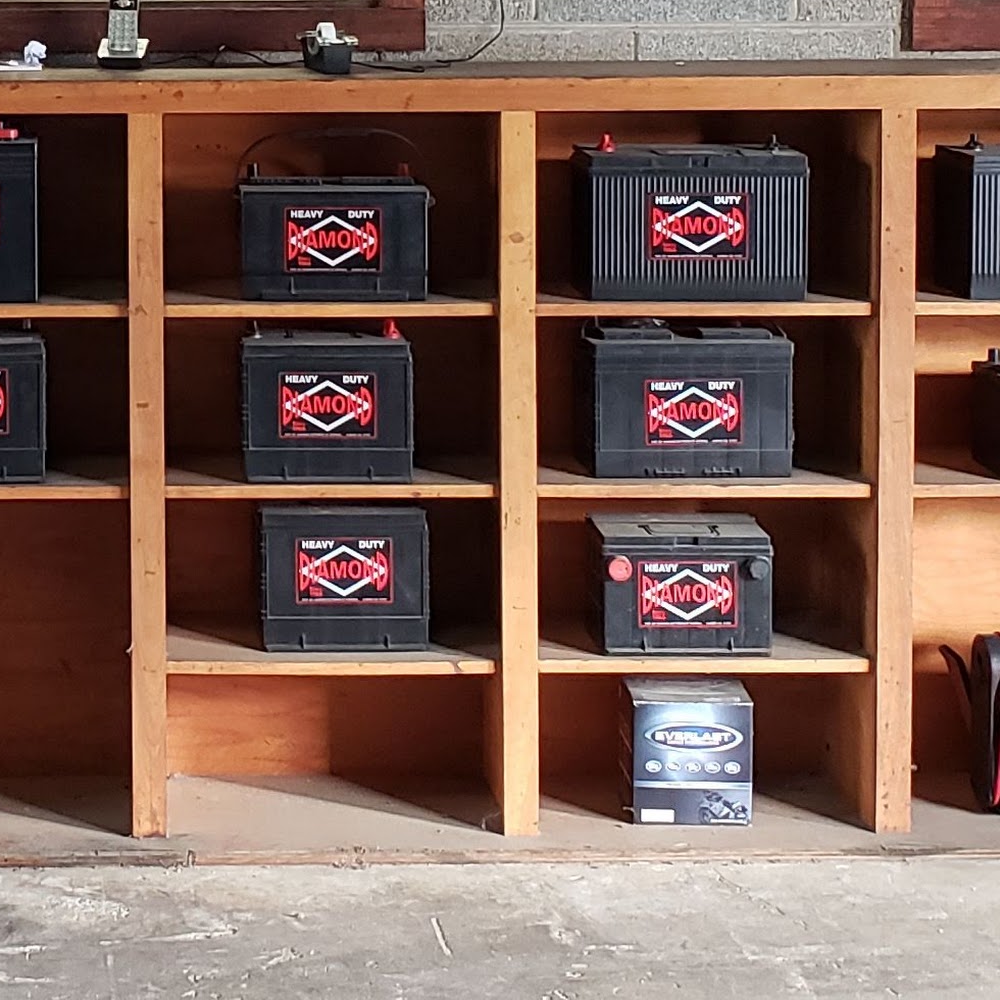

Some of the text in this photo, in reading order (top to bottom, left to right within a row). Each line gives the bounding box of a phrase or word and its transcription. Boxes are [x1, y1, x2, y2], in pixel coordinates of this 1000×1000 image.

[655, 195, 742, 204] HEAVY DUTY
[290, 210, 375, 218] HEAVY DUTY
[285, 375, 369, 384] HEAVY DUTY
[651, 381, 735, 391] HEAVY DUTY
[301, 540, 385, 549] HEAVY DUTY
[644, 563, 729, 573] HEAVY DUTY
